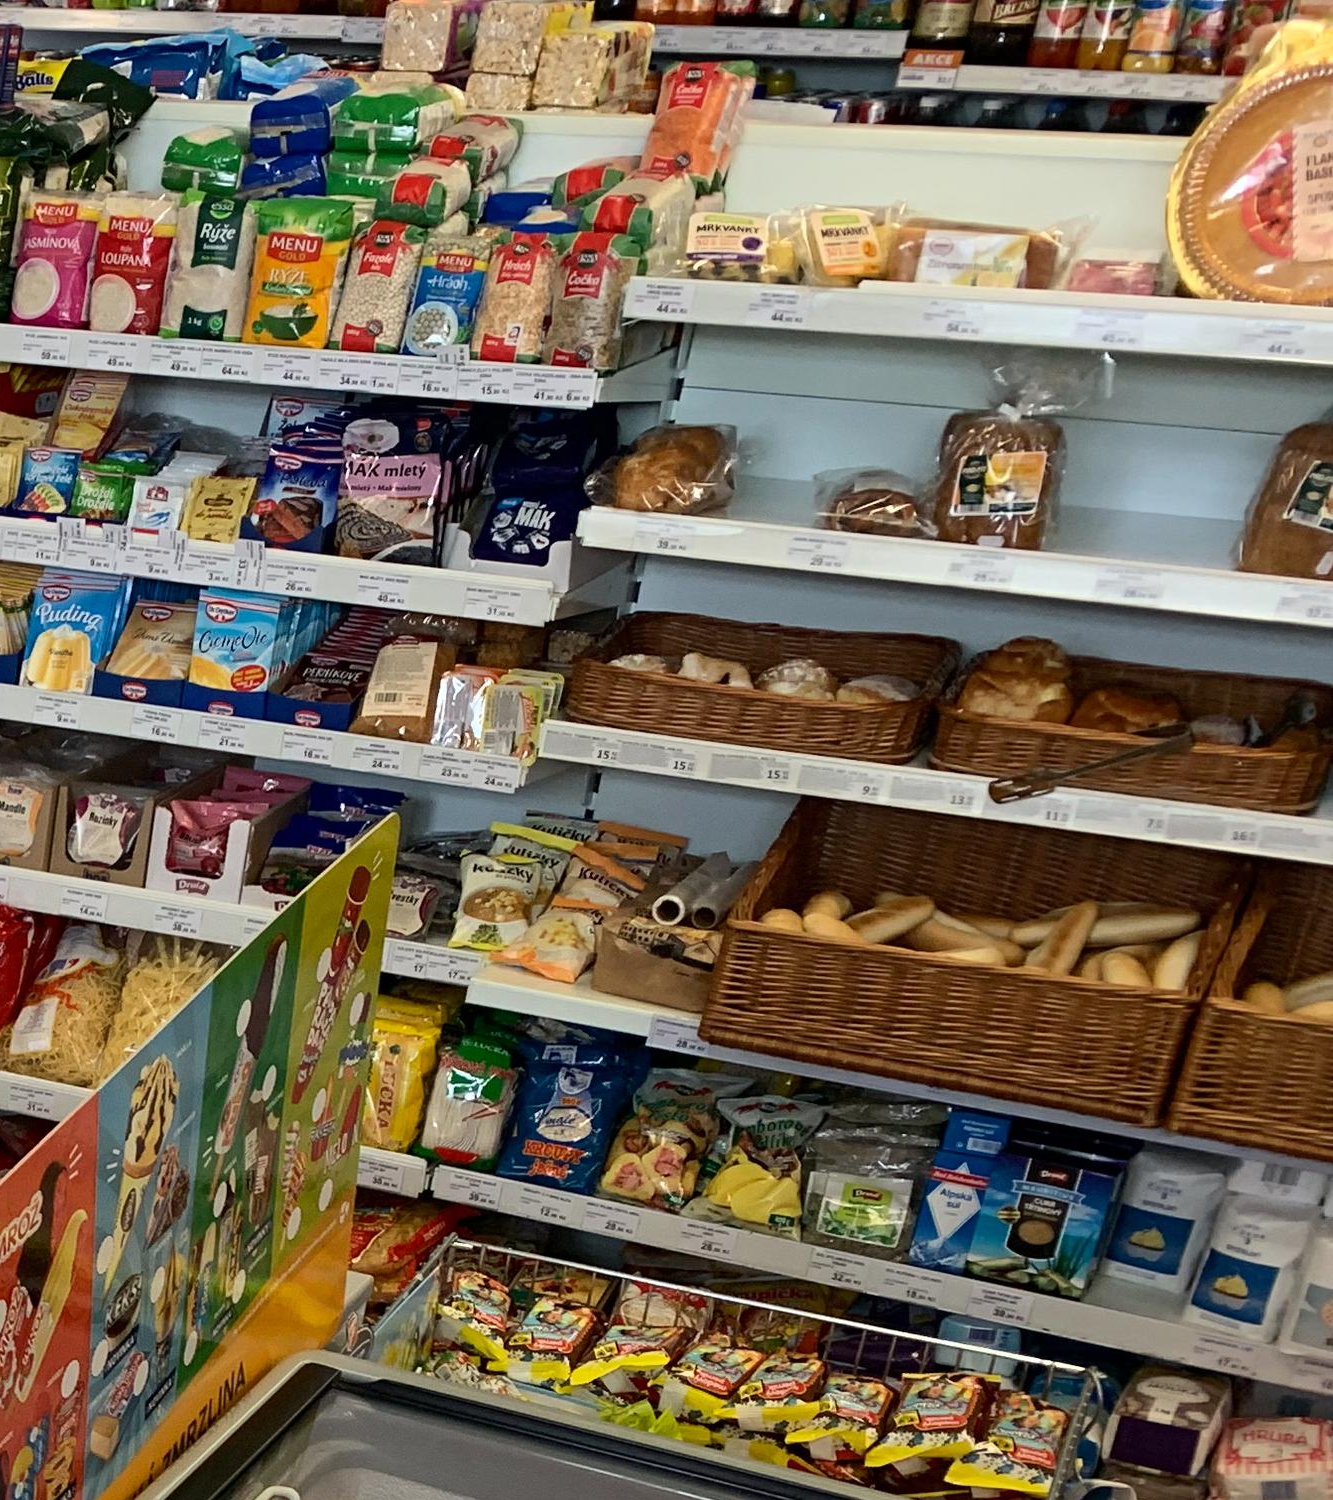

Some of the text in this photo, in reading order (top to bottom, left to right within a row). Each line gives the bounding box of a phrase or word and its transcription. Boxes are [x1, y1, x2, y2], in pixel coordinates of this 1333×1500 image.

[36, 204, 75, 220] MENU
[111, 218, 150, 235] MENU
[199, 222, 237, 247] Rýže
[270, 236, 319, 254] MENU
[278, 250, 307, 263] GOLD
[440, 255, 473, 268] MENU
[567, 271, 600, 288] Čočka
[385, 463, 428, 481] mletý
[514, 503, 554, 531] MÁK
[36, 602, 103, 632] Puding
[161, 1360, 247, 1476] ZMRZLINA
